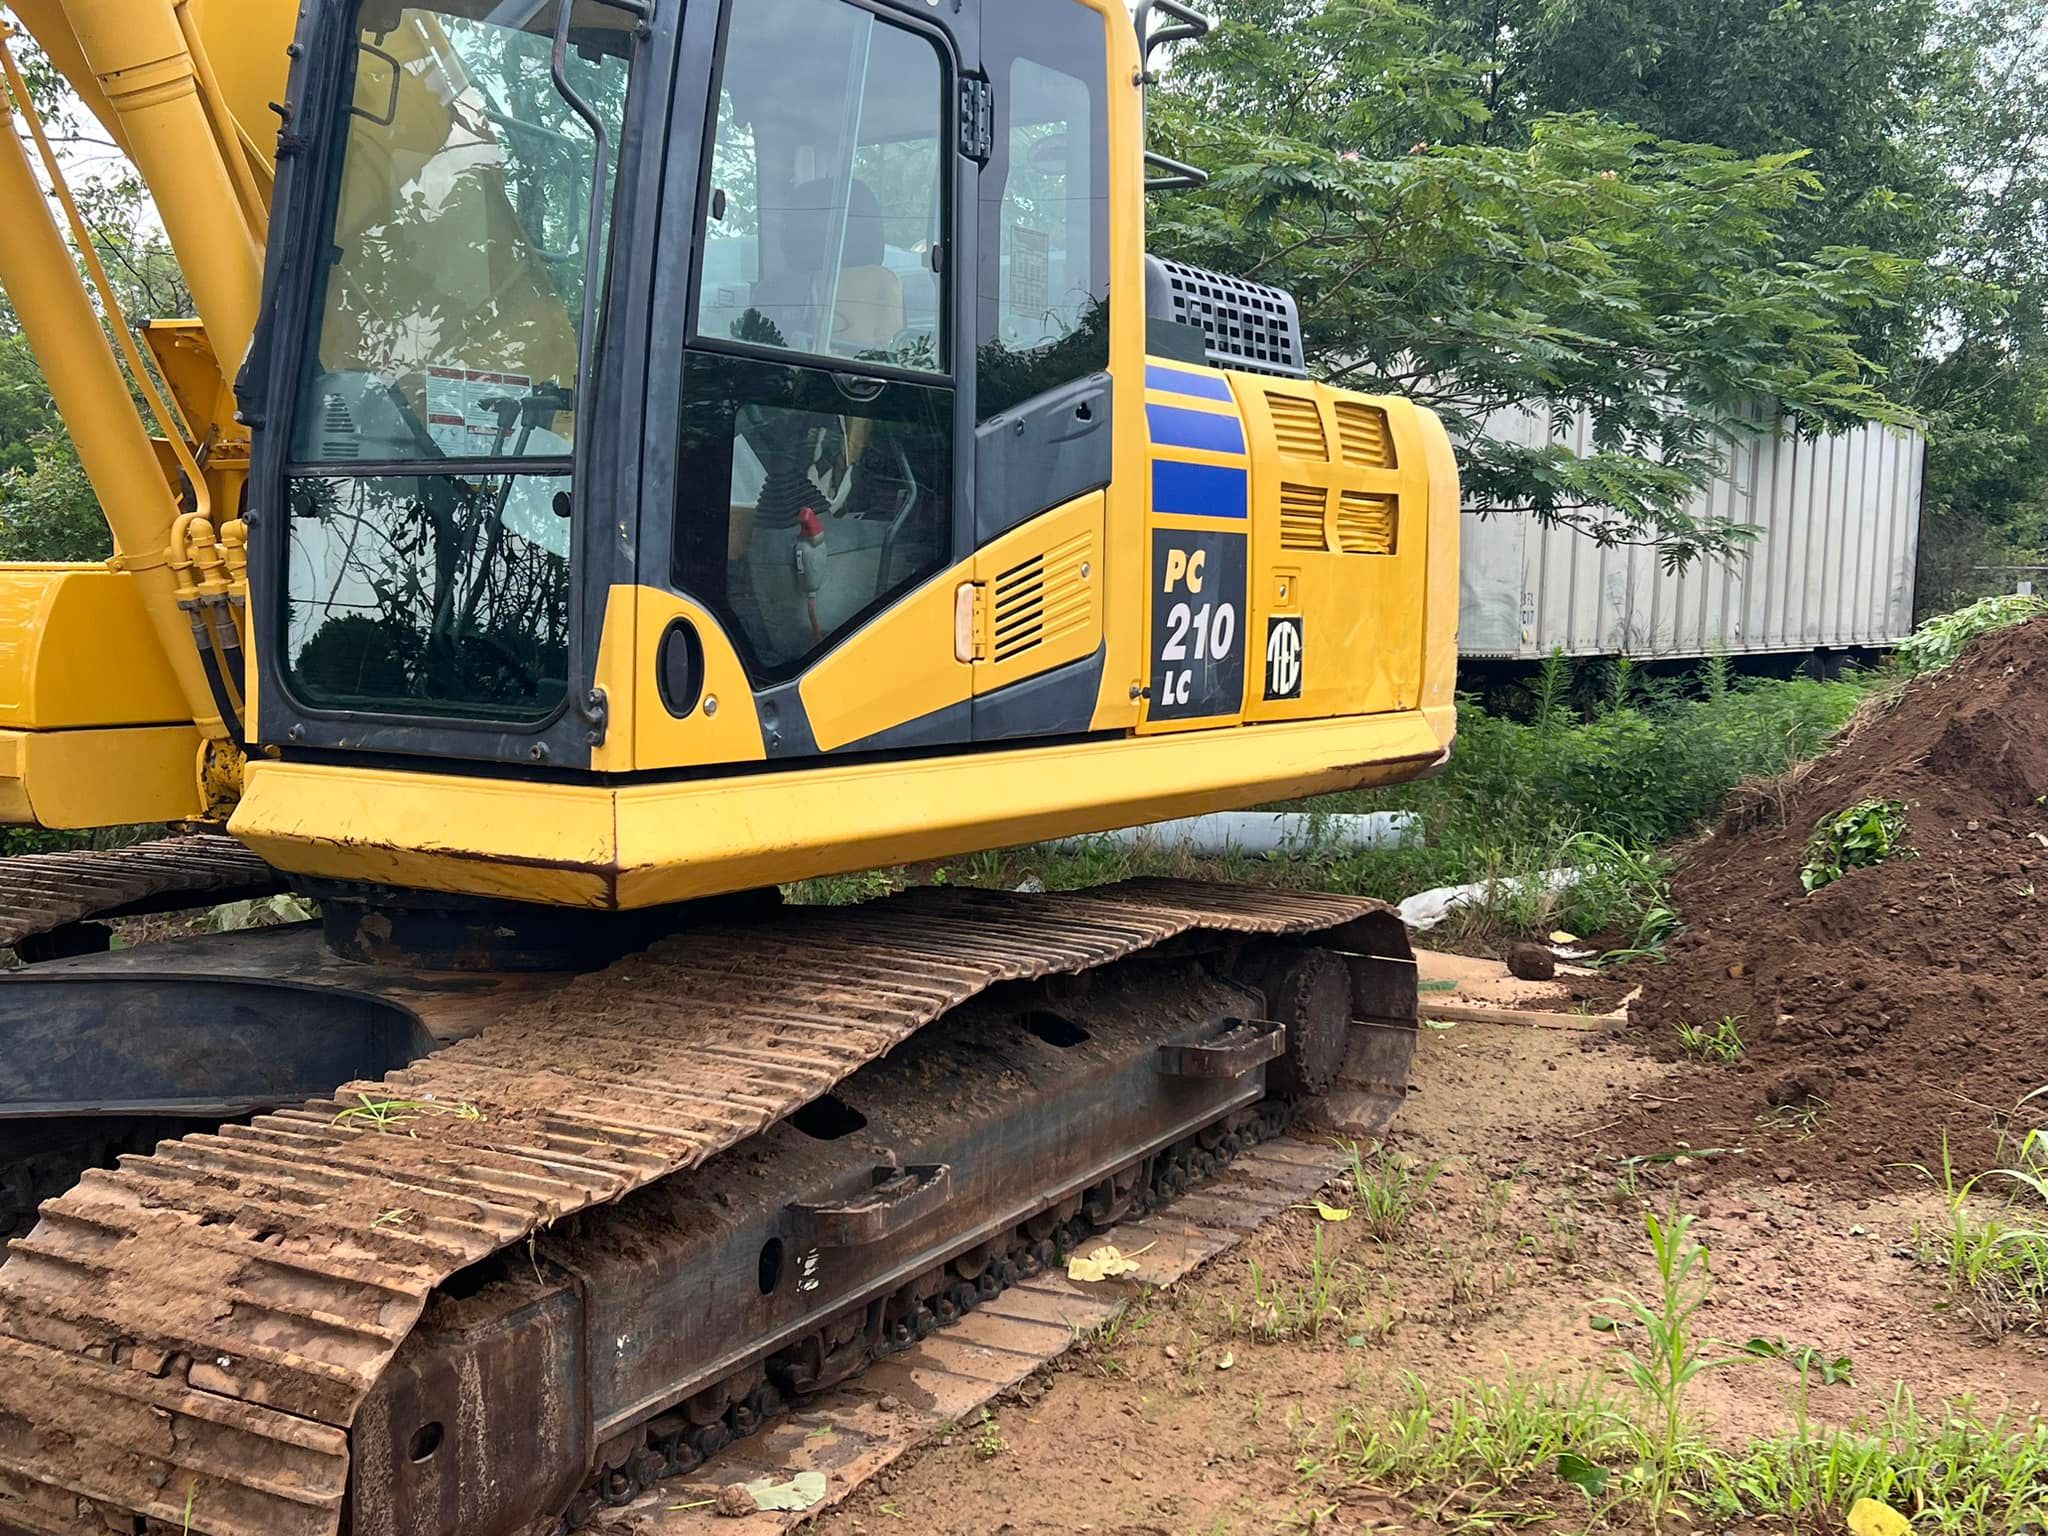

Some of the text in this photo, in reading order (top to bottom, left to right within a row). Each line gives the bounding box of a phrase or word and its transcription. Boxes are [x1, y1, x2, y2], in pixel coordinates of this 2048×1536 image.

[1164, 549, 1206, 594] PC
[1161, 602, 1235, 661] 210
[1161, 669, 1192, 706] LC
